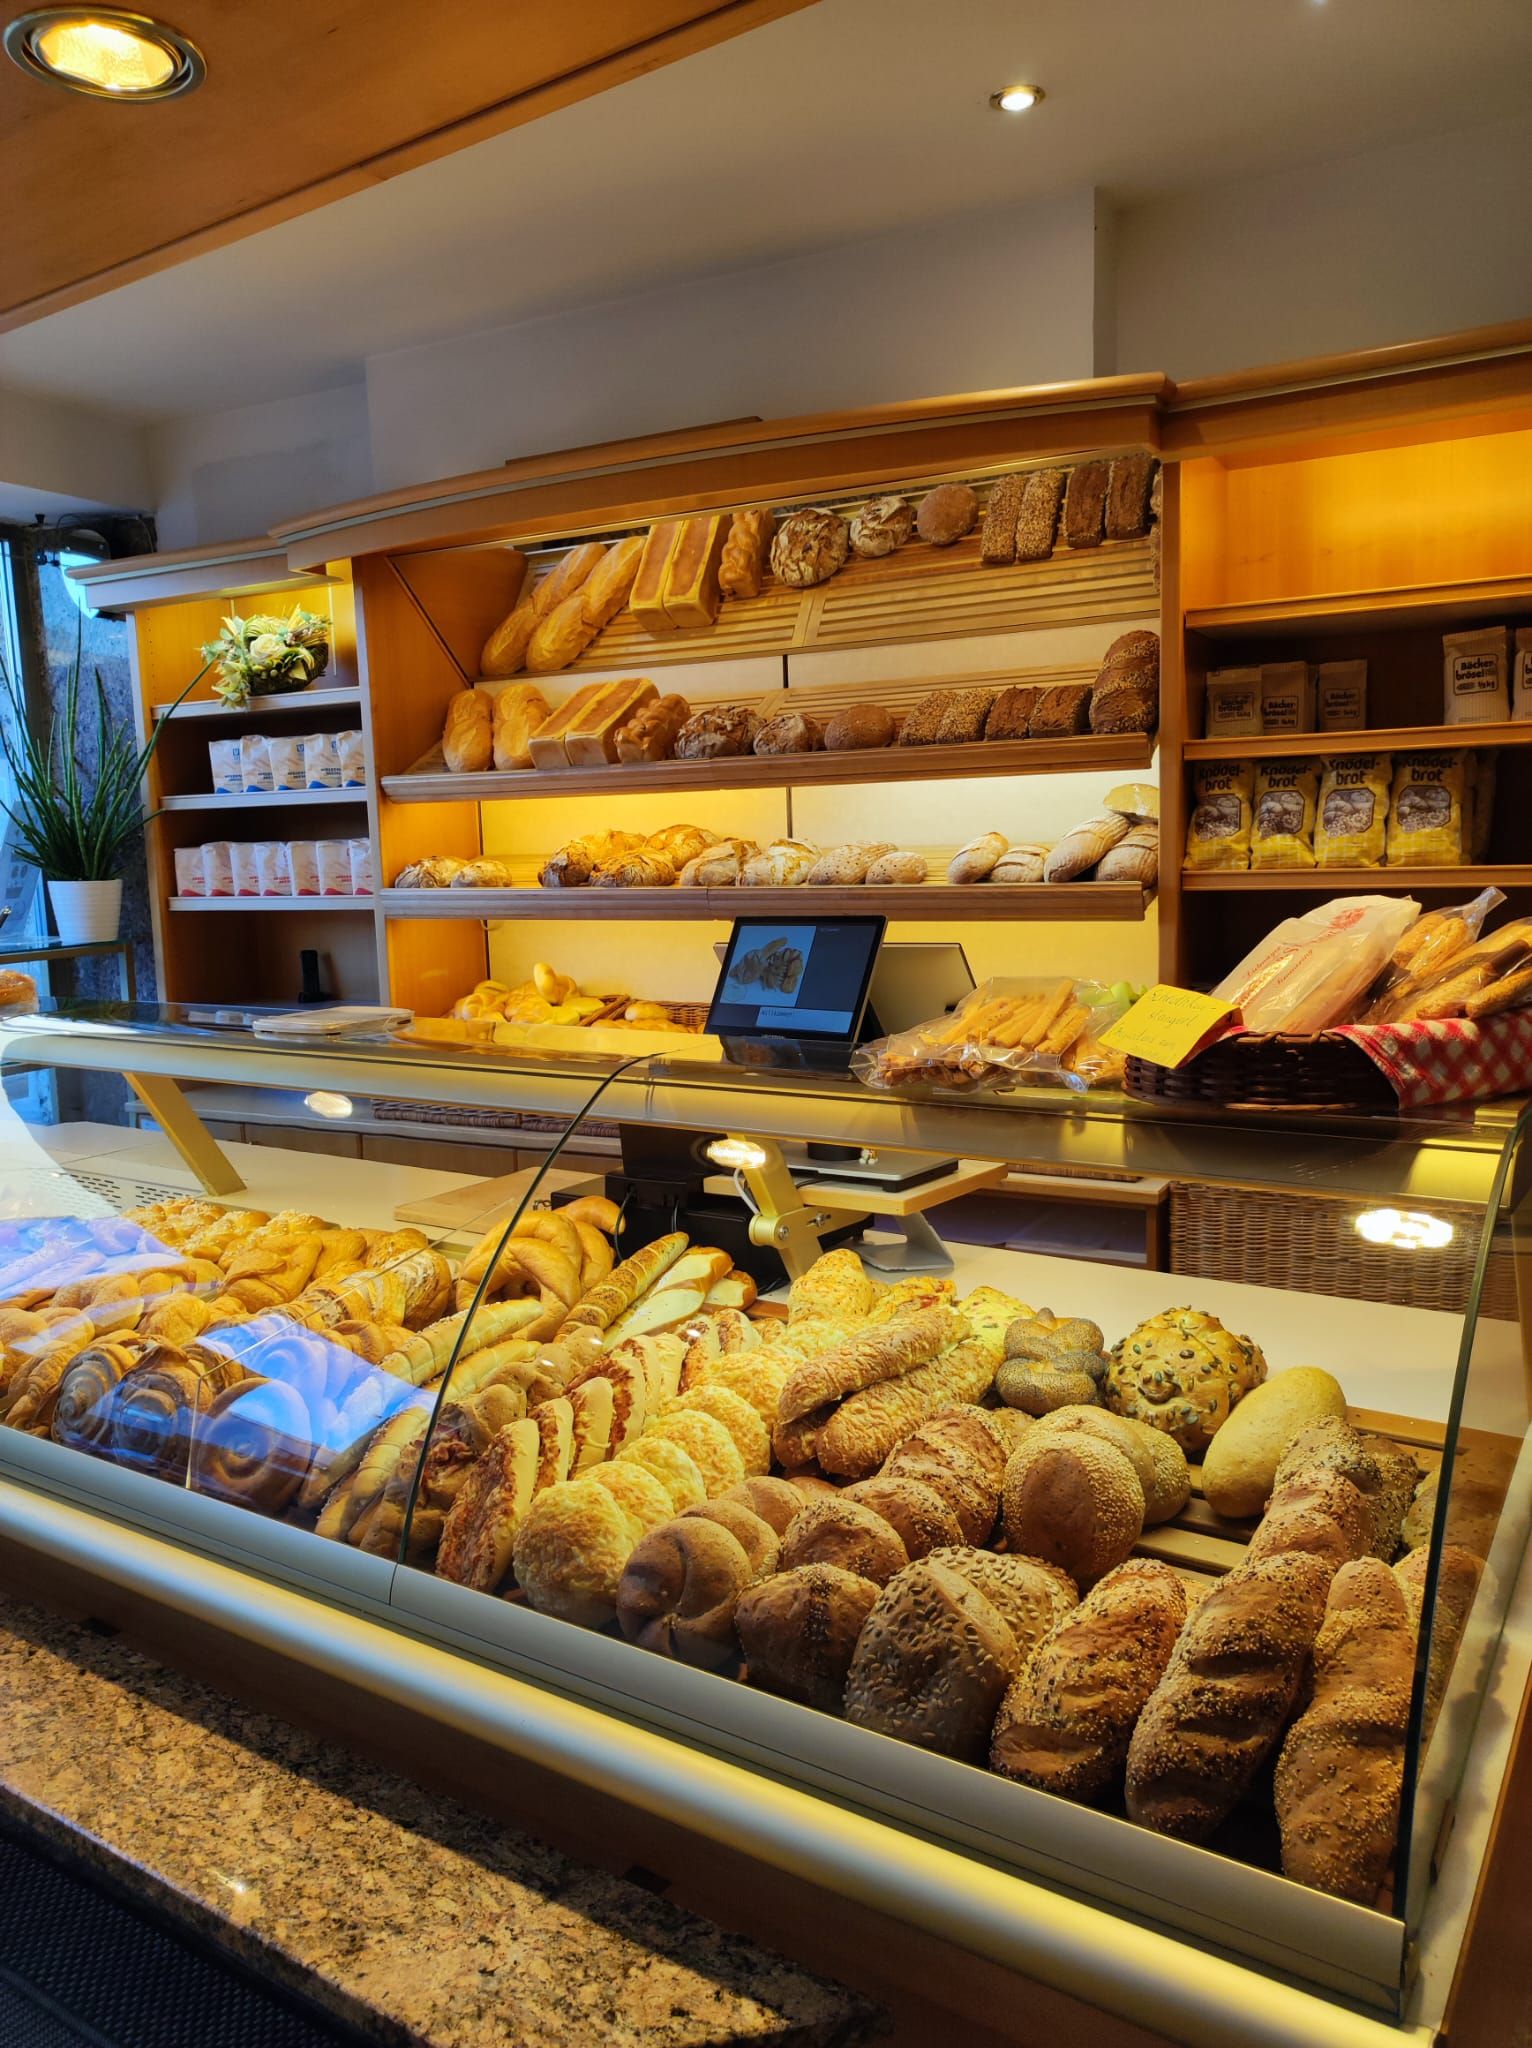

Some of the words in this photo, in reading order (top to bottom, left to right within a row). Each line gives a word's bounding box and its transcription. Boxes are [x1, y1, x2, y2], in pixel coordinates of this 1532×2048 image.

[1268, 774, 1299, 788] brot
[1335, 769, 1366, 786] brot
[1411, 766, 1443, 783] brot
[1204, 775, 1233, 793] brot
